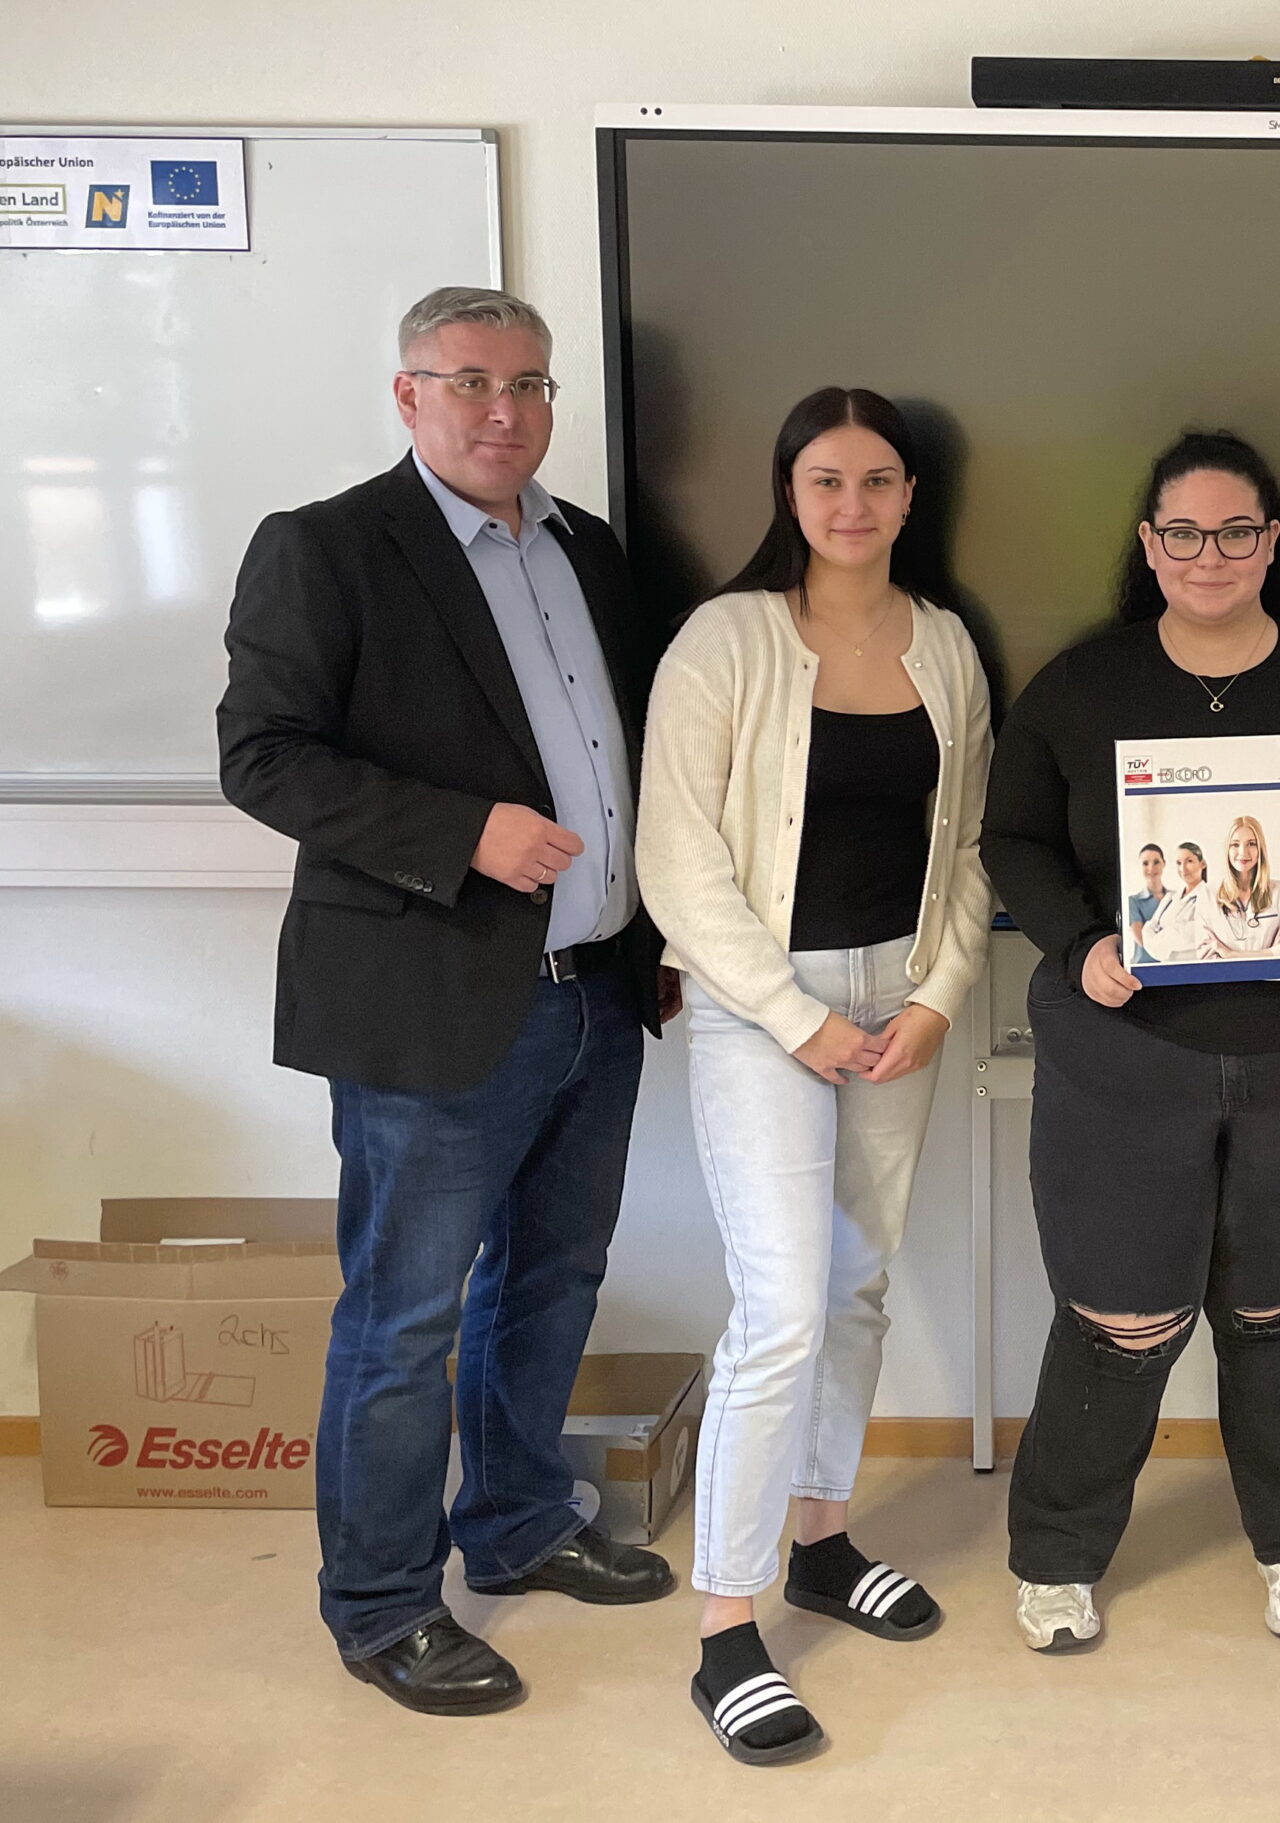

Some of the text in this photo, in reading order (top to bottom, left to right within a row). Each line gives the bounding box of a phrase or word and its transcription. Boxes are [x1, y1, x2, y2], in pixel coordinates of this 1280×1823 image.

[59, 156, 94, 168] Union
[22, 191, 59, 206] Land
[26, 216, 69, 227] Österreich
[212, 212, 226, 220] der
[148, 220, 226, 229] Europäischen Union
[1127, 759, 1150, 769] TÜV
[136, 1427, 311, 1471] Esselte
[136, 1486, 269, 1499] www.esselte.com
